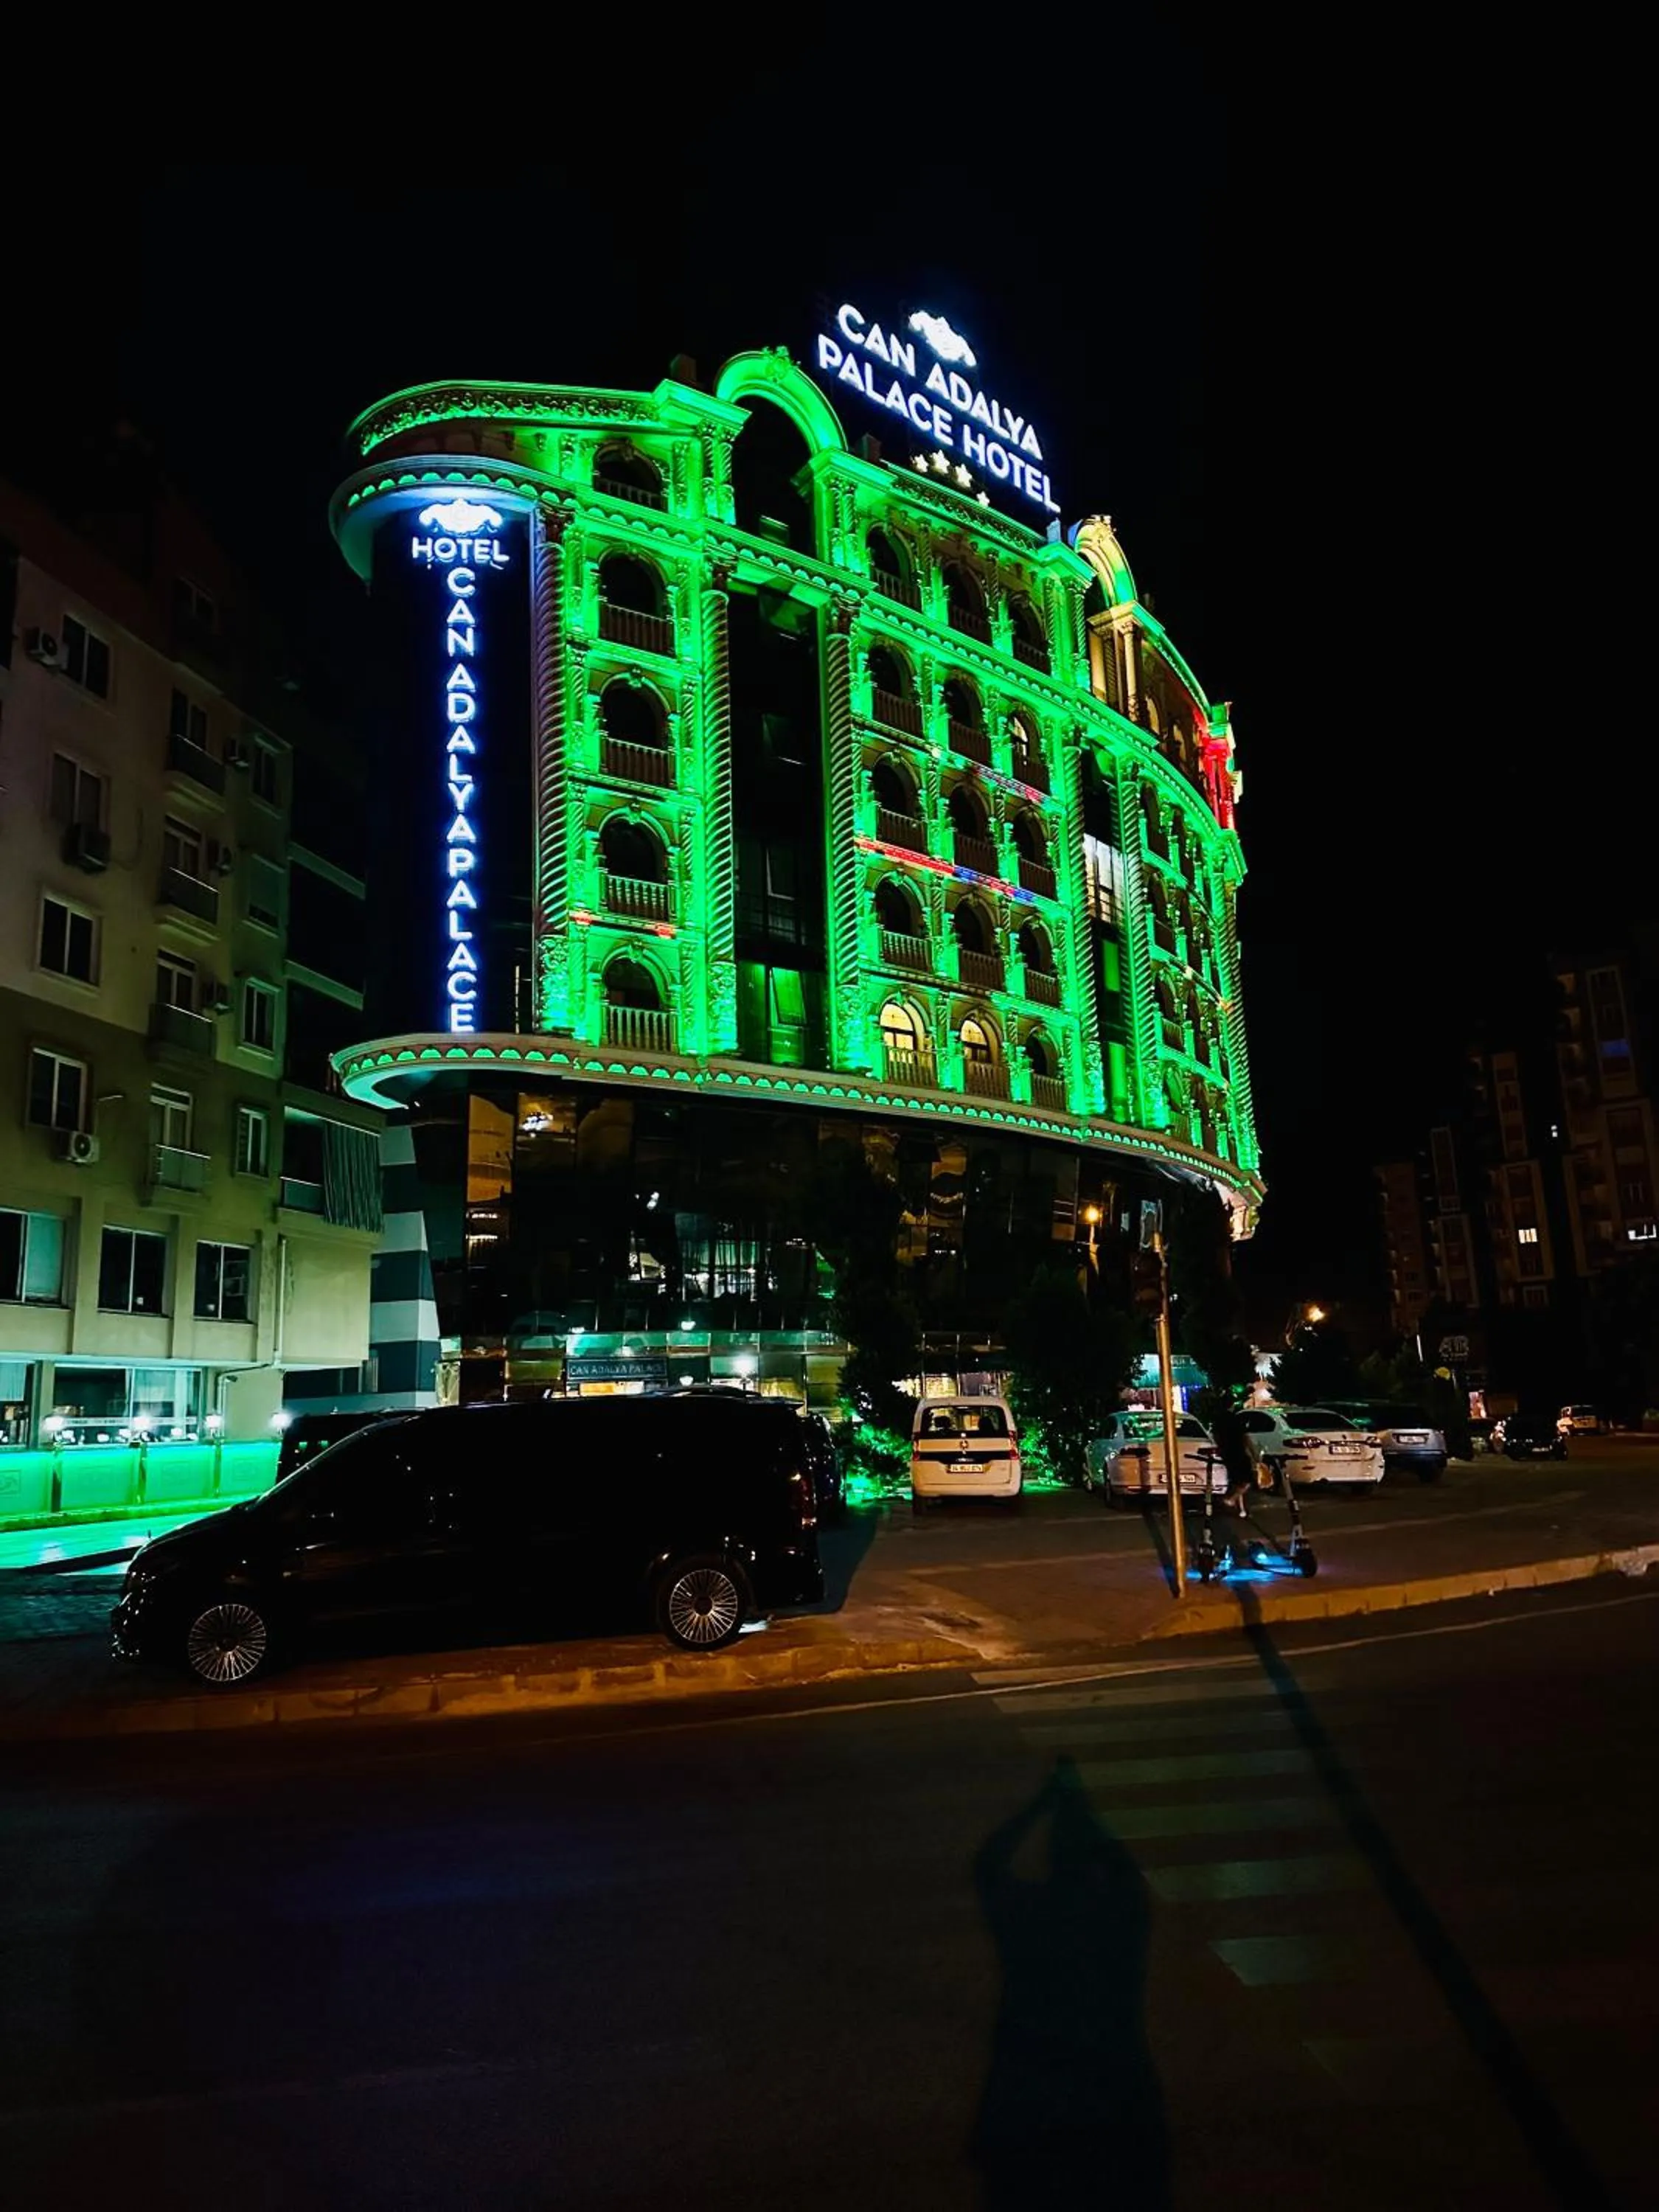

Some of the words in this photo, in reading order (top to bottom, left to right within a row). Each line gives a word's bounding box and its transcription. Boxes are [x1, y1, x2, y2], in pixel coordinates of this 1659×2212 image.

[817, 333, 953, 445] PALACE
[962, 424, 1061, 513] HOTEL
[838, 303, 916, 376] CAN
[925, 362, 1043, 460] ADALYA
[411, 536, 509, 562] HOTEL
[446, 566, 476, 657] CAN
[446, 848, 477, 1033] PALACE
